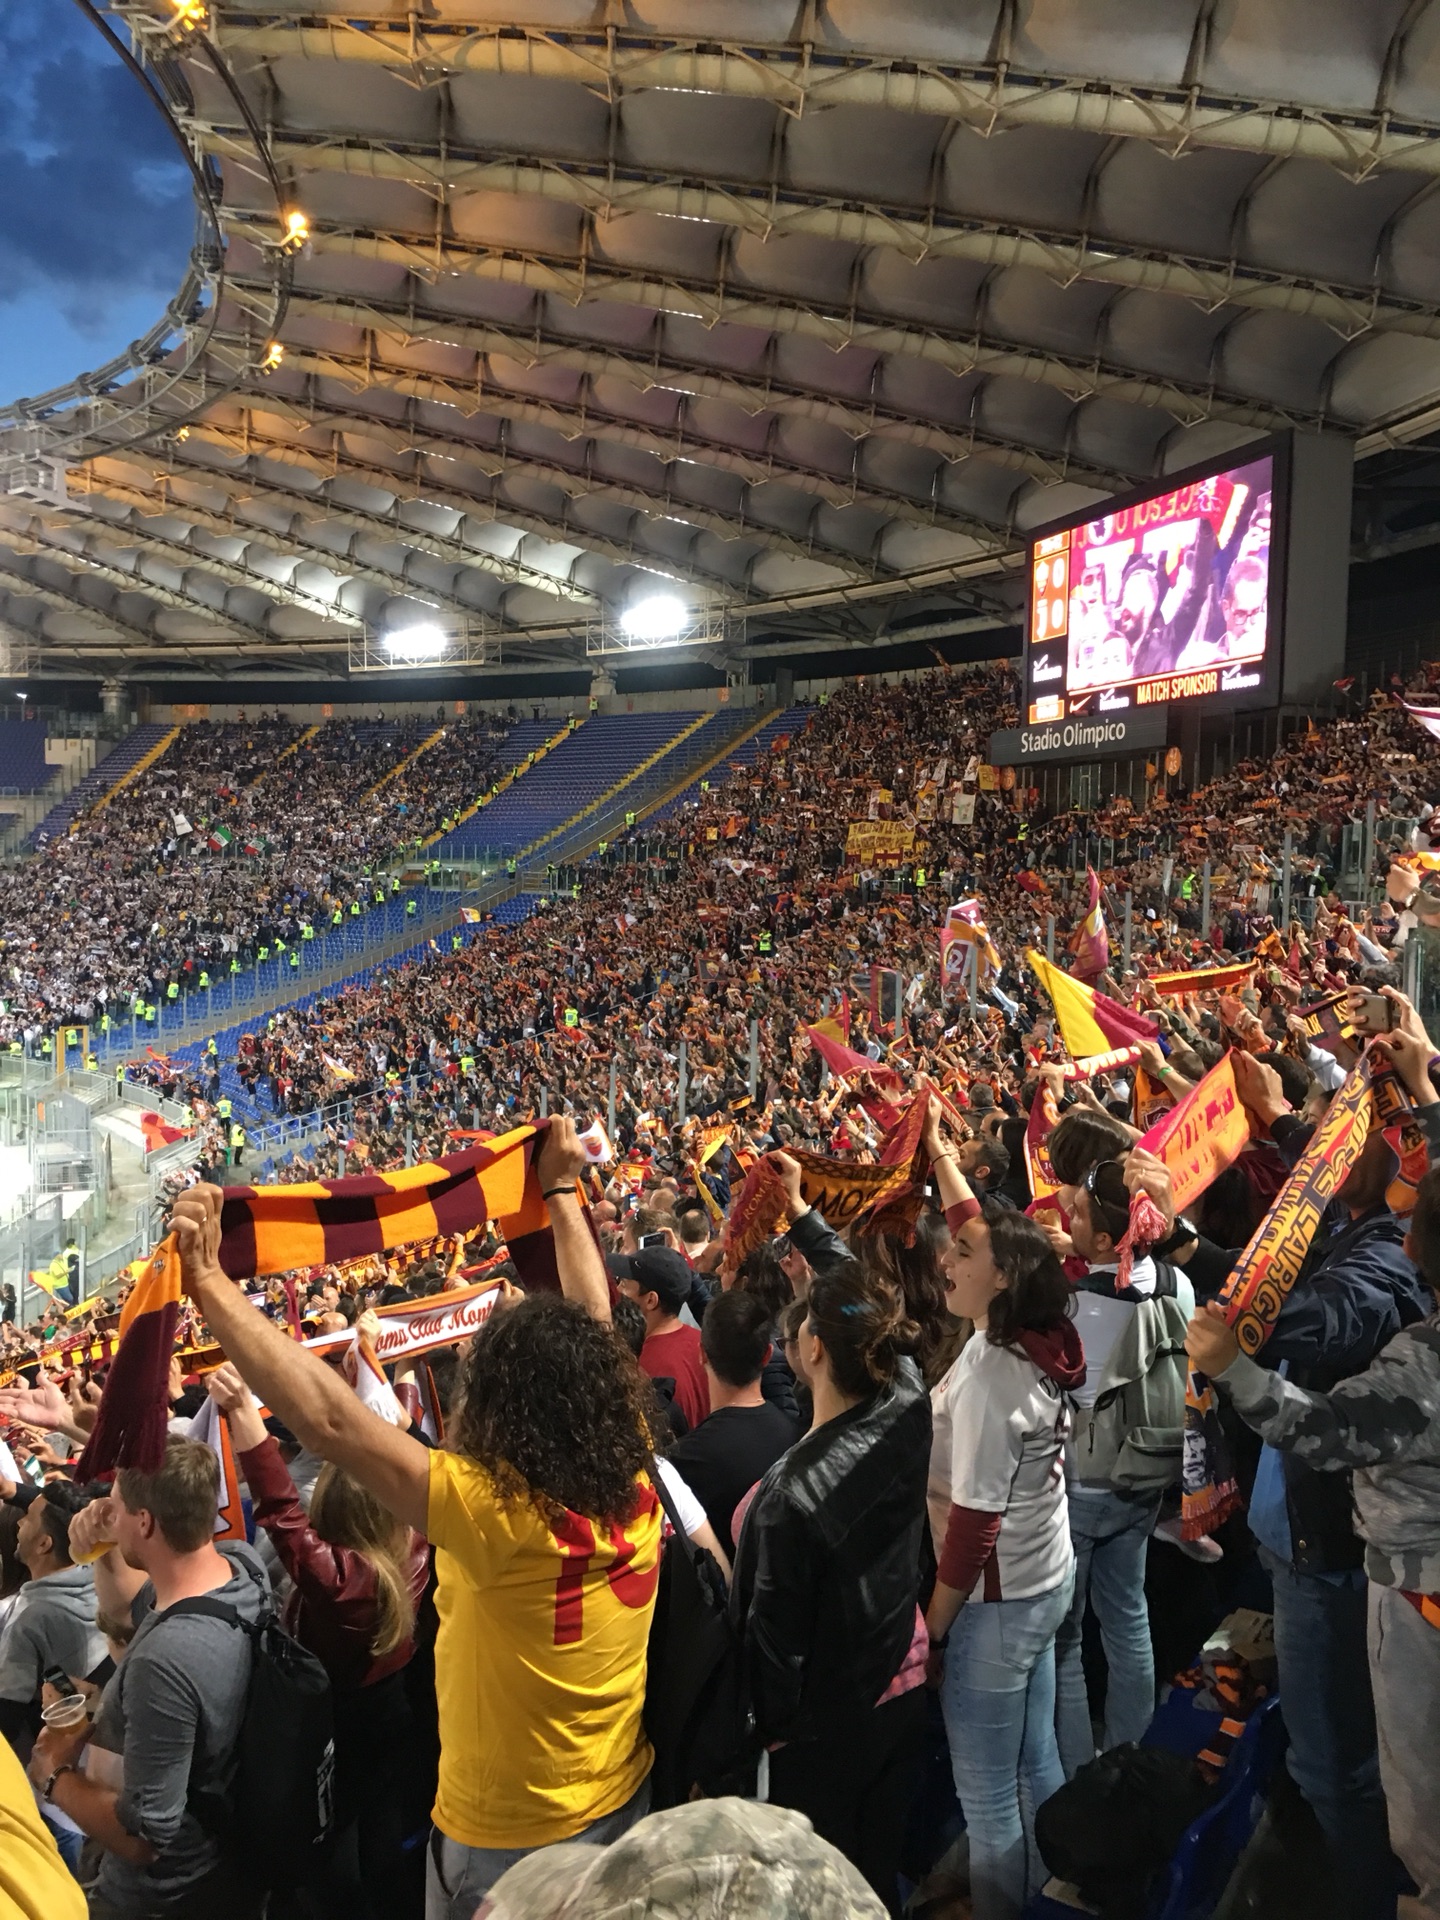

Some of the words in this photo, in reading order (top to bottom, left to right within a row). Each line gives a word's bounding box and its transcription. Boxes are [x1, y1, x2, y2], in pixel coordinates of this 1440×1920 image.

[1137, 680, 1170, 704] MATCH
[1171, 671, 1218, 699] SPONSOR
[1021, 727, 1061, 753] Stadio
[1063, 718, 1126, 748] Olimpico
[743, 1180, 773, 1220] ROMA
[1235, 1197, 1322, 1357] LARGO
[374, 1328, 409, 1354] oma
[408, 1311, 448, 1340] Club
